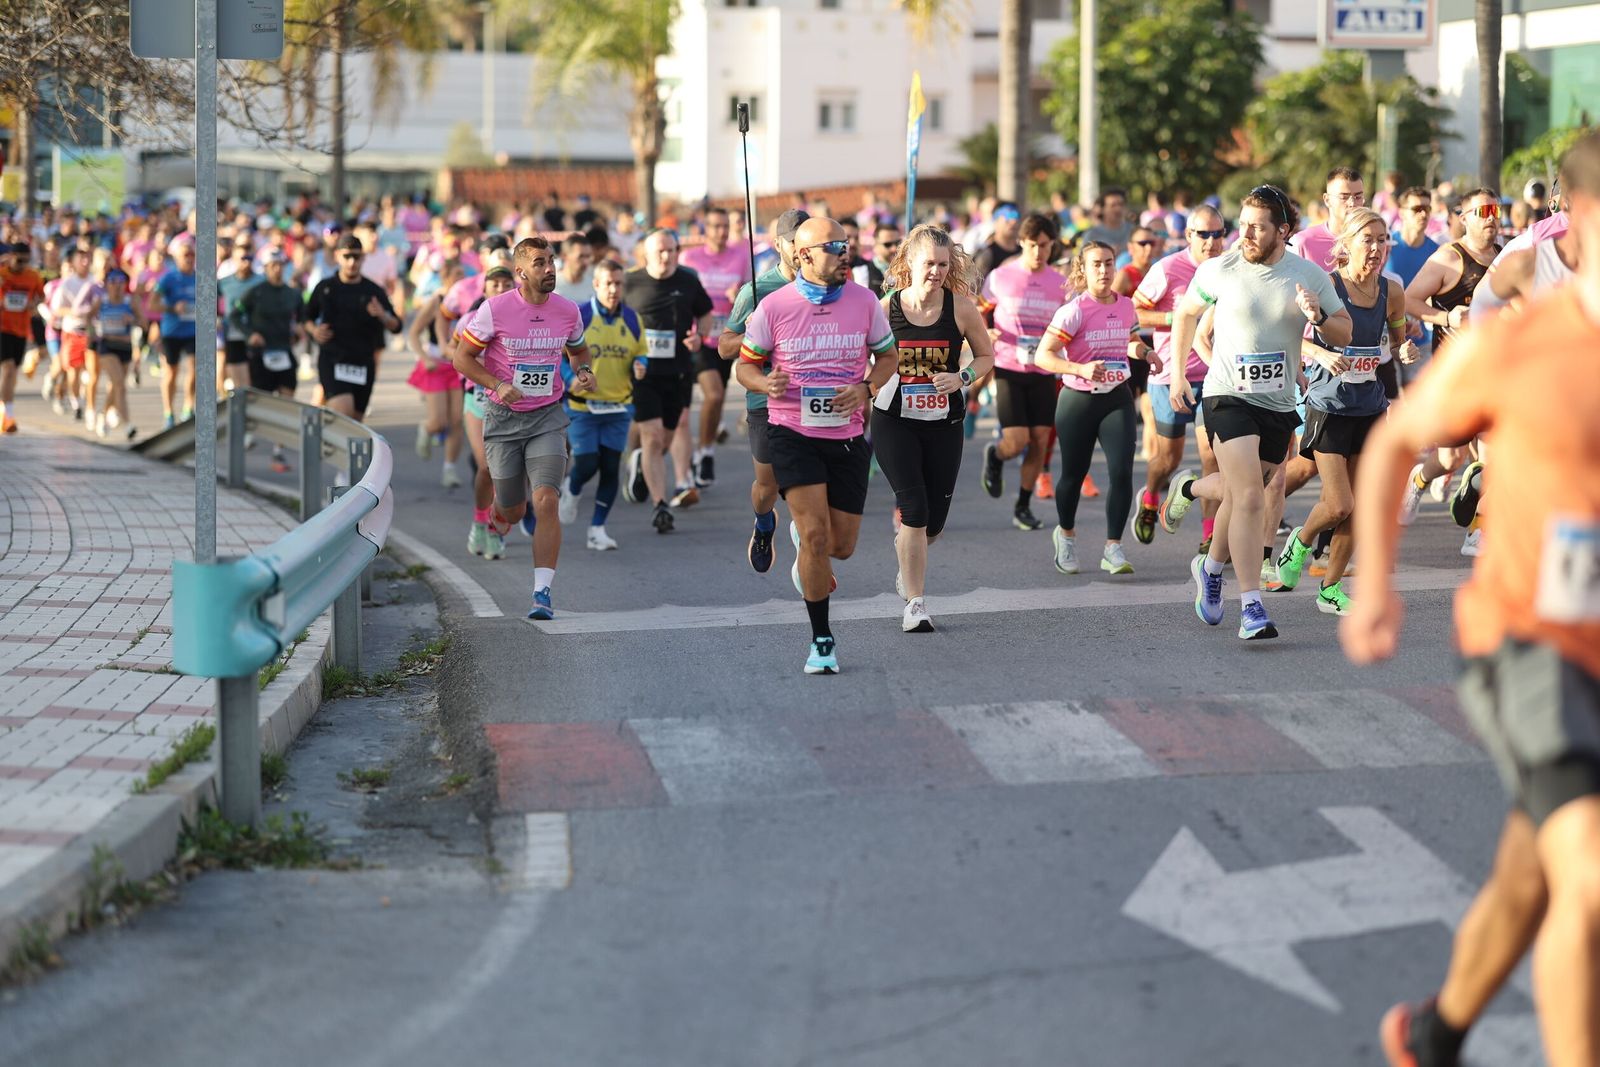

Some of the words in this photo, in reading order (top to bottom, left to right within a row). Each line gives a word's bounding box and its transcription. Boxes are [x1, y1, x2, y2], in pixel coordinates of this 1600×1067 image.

[1339, 9, 1417, 30] ALDI
[528, 328, 550, 337] XXXVI
[810, 323, 839, 335] XXXVI
[1085, 330, 1109, 341] MEDIA
[502, 337, 531, 350] MEDIA
[780, 336, 813, 352] MEDIA
[784, 350, 843, 361] INTERNACIONAL
[899, 347, 950, 364] RUN
[1238, 363, 1283, 380] 1952
[521, 373, 548, 386] 235
[810, 398, 834, 413] 65
[906, 394, 947, 409] 1589
